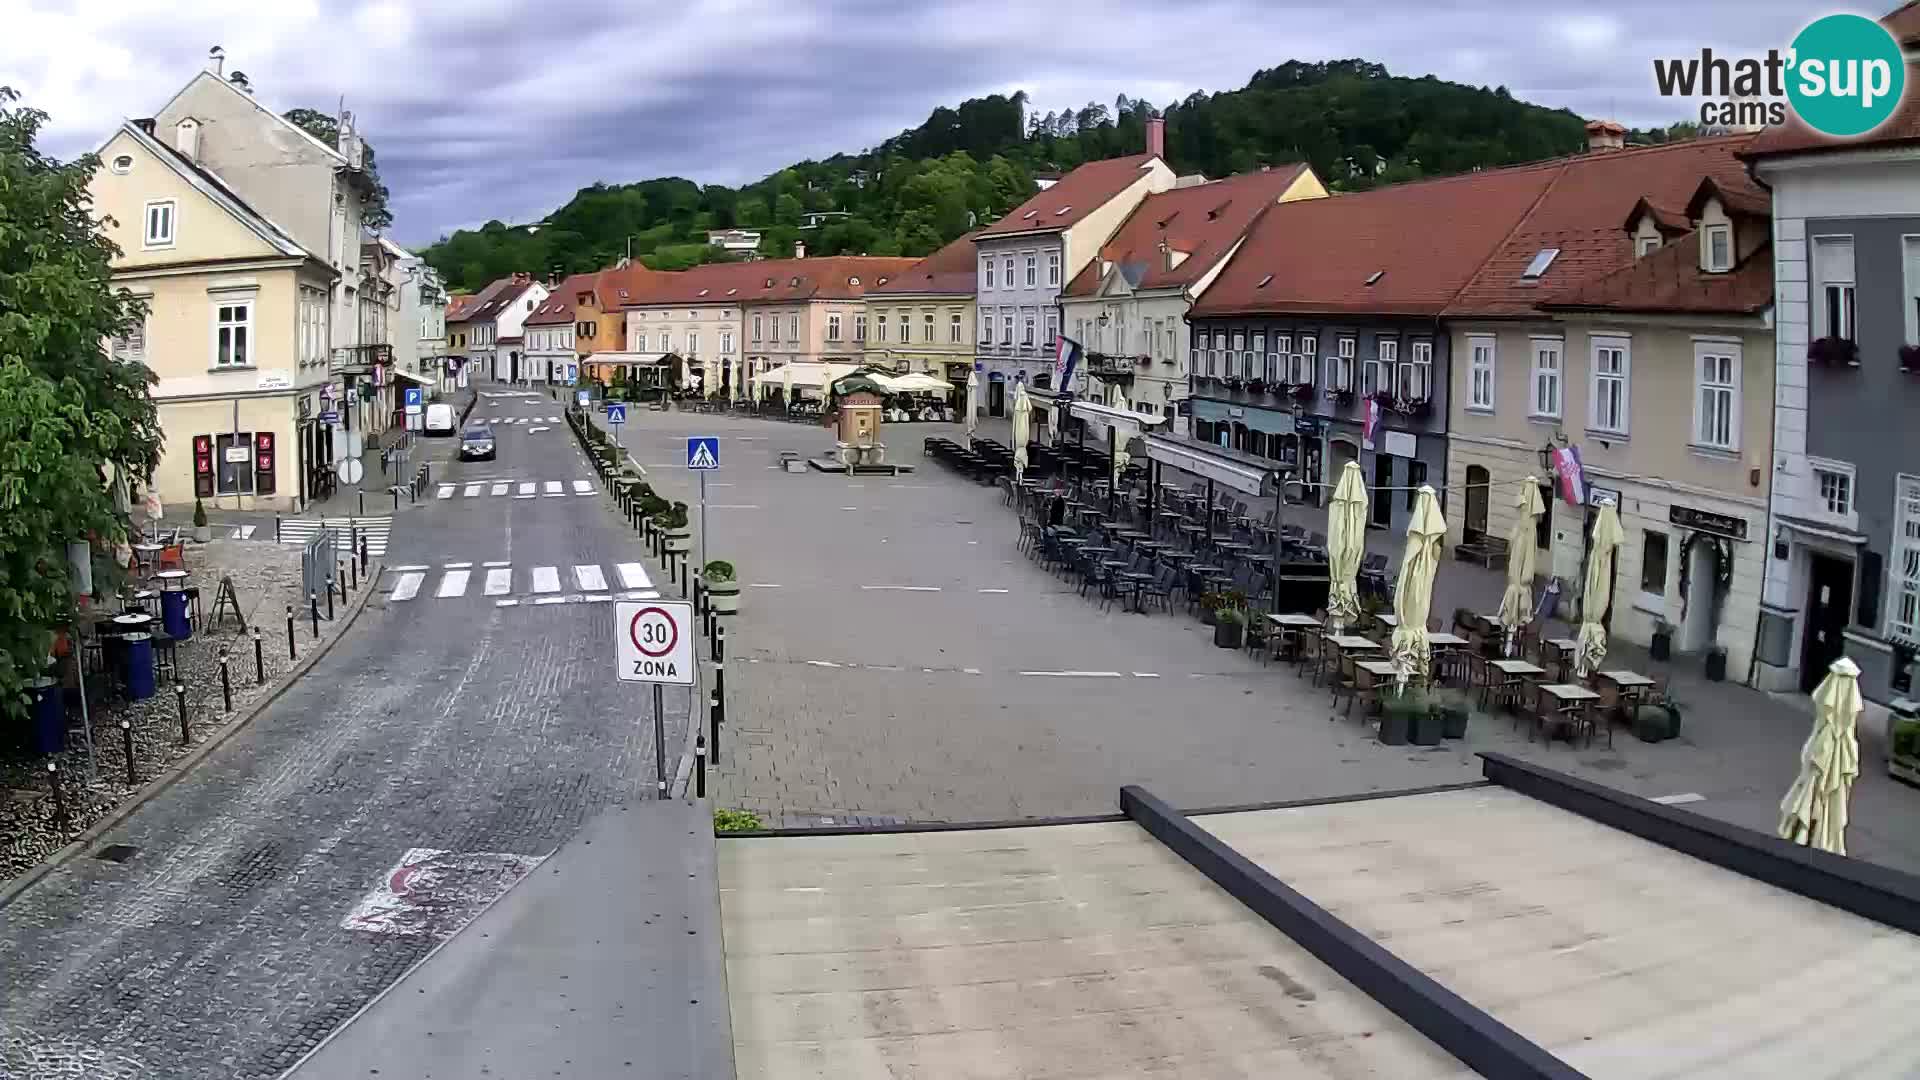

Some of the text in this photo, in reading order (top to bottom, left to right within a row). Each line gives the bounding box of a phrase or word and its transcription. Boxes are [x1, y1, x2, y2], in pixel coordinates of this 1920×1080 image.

[409, 392, 417, 402] P
[642, 623, 666, 644] 30
[633, 660, 678, 677] ZONA
